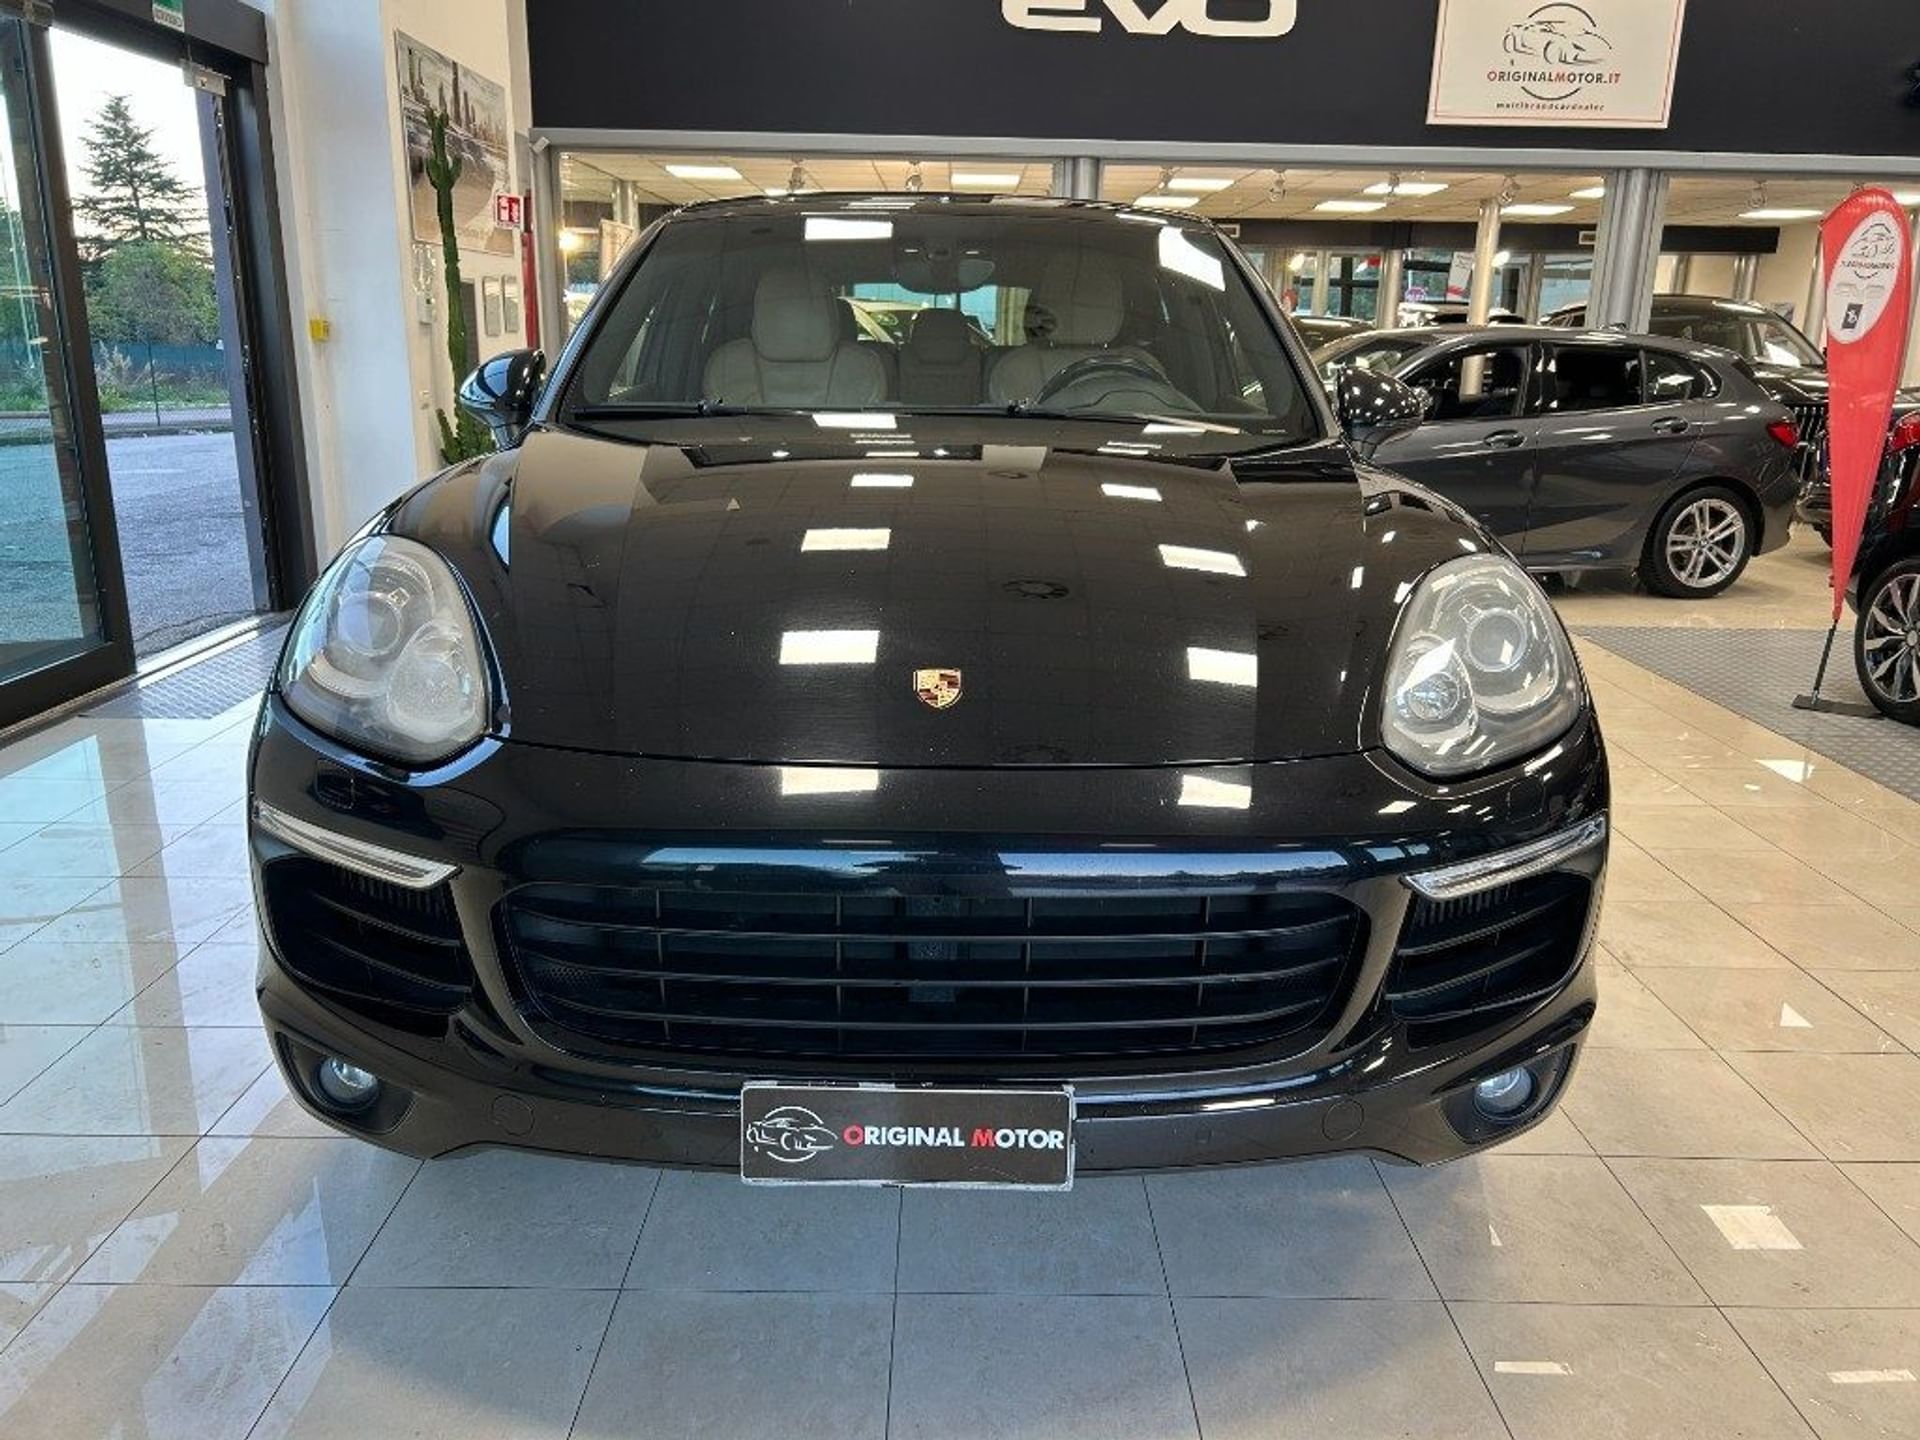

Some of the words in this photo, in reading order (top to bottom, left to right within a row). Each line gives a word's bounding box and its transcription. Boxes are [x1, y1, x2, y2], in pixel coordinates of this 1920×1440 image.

[1487, 71, 1621, 84] ORIGINALMOTOR.IT
[843, 1125, 965, 1147] ORIGINAL
[971, 1128, 1064, 1149] MOTOR
